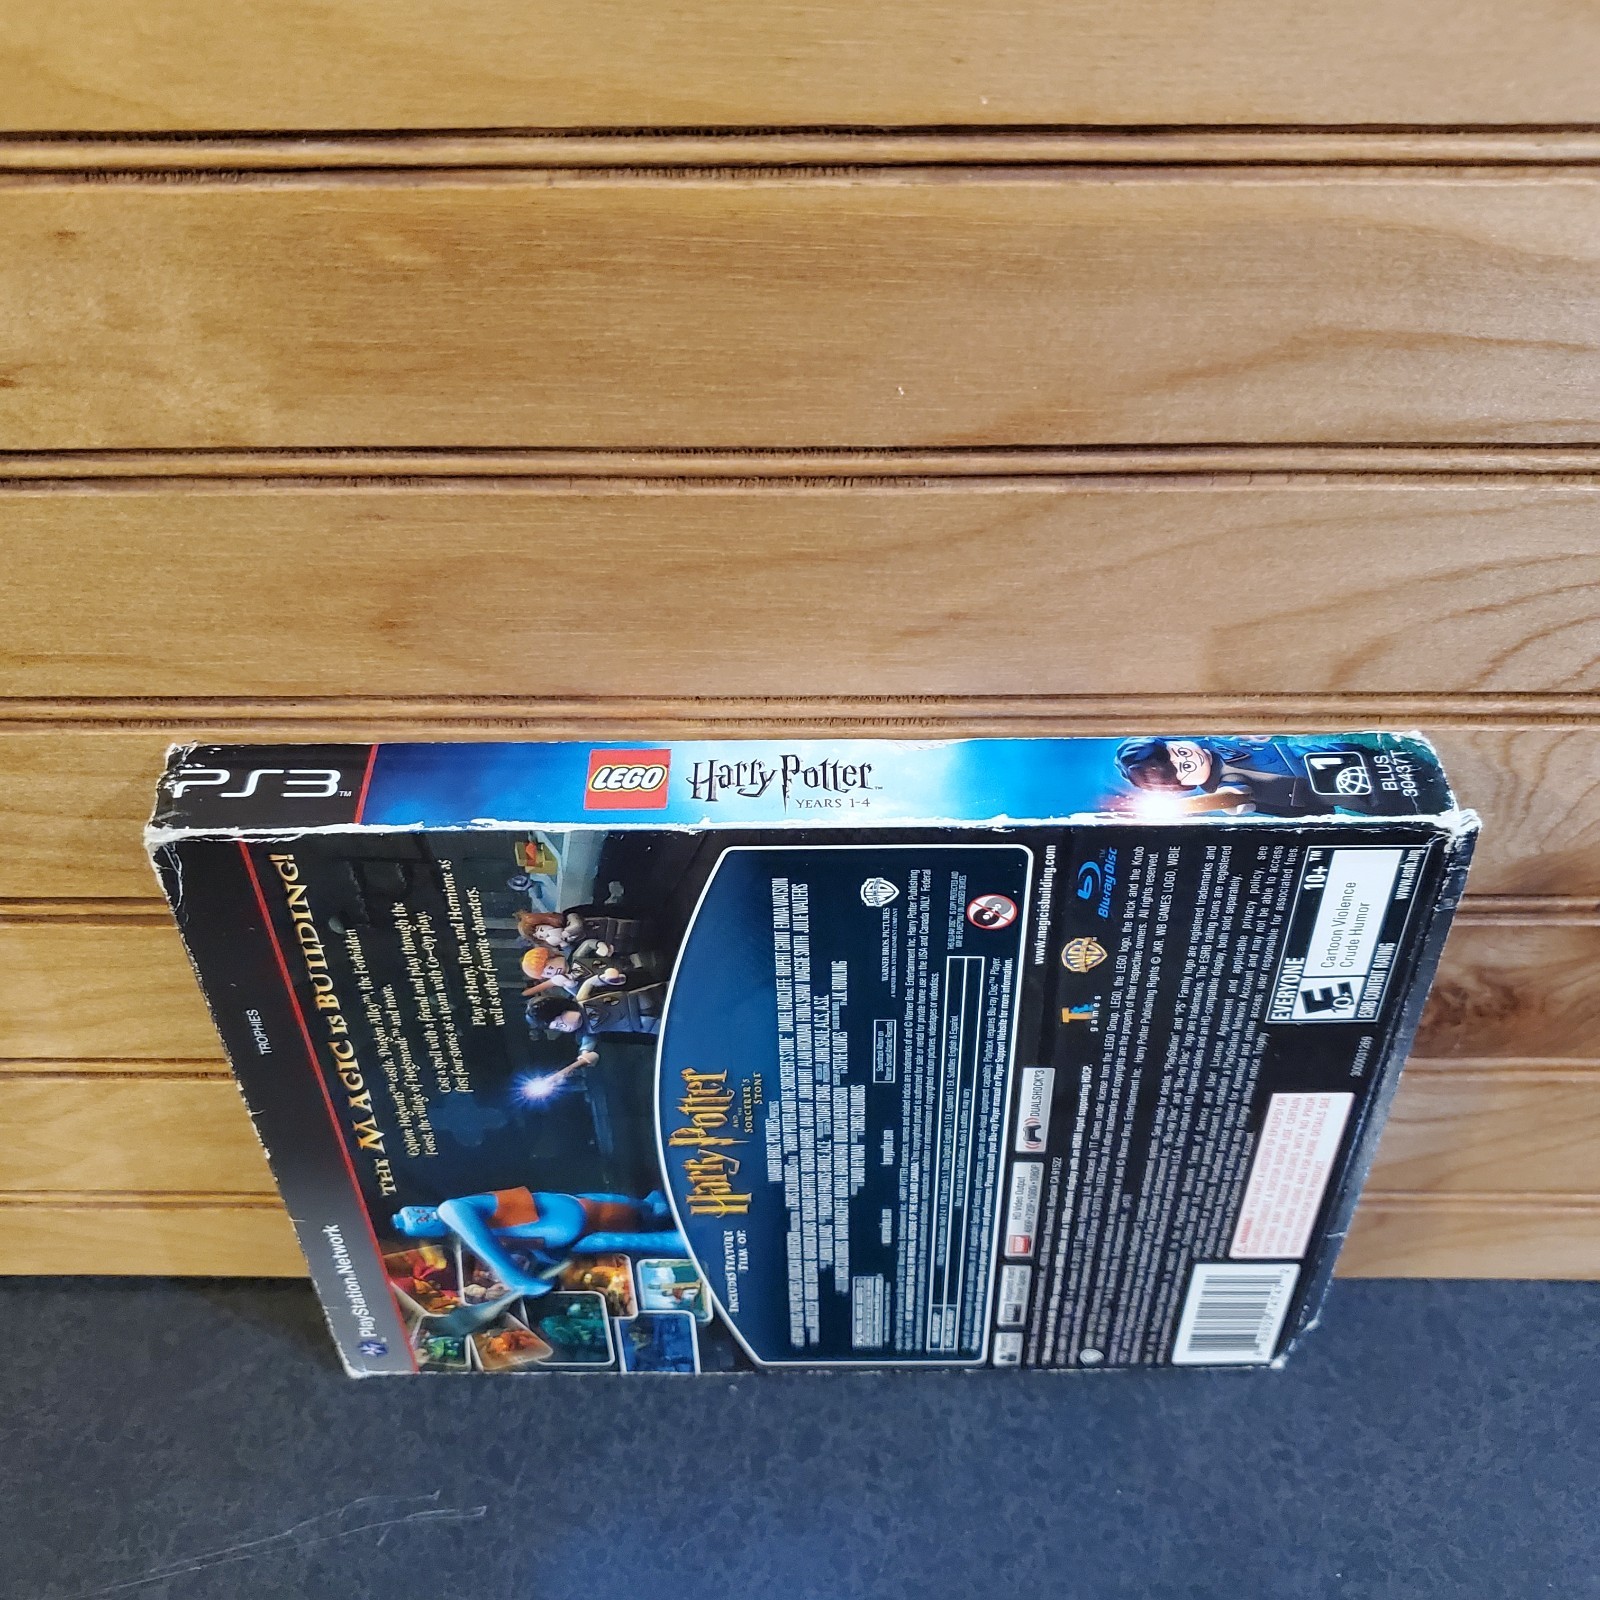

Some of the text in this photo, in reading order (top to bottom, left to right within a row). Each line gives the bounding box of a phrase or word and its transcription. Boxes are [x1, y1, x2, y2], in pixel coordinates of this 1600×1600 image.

[172, 768, 341, 798] PS3
[592, 764, 664, 791] LEGO
[686, 754, 876, 813] Harry Potter
[1374, 755, 1398, 791] BLUS
[795, 798, 870, 809] YEARS 1-4
[1097, 847, 1117, 917] Blu-ray Disc
[1122, 845, 1144, 918] Brick and the Knob
[1137, 852, 1158, 918] All rights reserved.
[1303, 865, 1327, 889] 10+
[1395, 849, 1424, 899] www.esrb.org
[771, 877, 789, 907] WATSON
[906, 869, 922, 936] Harry Potter Publishing
[918, 868, 931, 934] Canada ONLY. Federal
[1034, 845, 1055, 964] www.magicisbuilding.com
[1154, 846, 1180, 936] WB GAMES LOGO, WBIE
[1189, 845, 1217, 943] registered trademarks and
[1221, 874, 1242, 930] sold separately.
[391, 902, 407, 917] the
[415, 911, 435, 933] play.
[772, 903, 789, 928] EMMA
[881, 907, 890, 937] PICTURES
[394, 919, 416, 954] through
[1320, 882, 1356, 968] Cartoon Violence
[1339, 902, 1369, 967] Crude Humor
[345, 929, 368, 974] Forbidden
[437, 859, 486, 1025] Play as Harry, Ron, and Hermione as
[773, 931, 790, 951] GRINT
[406, 956, 424, 976] play
[466, 887, 505, 1025] well as other favorite characters.
[774, 951, 791, 976] RUPERT
[881, 955, 889, 981] WARNER
[357, 975, 373, 990] the
[408, 977, 425, 994] and
[427, 969, 444, 990] with
[831, 960, 847, 990] ROWLING
[1271, 957, 1304, 1020] EVERYONE
[1357, 942, 1395, 1018] ESRB CONTENT RATING
[382, 983, 397, 1008] more.
[436, 991, 451, 1014] team
[775, 978, 792, 1010] RADCLIFFE
[791, 883, 813, 1100] JOHN HURT ALAN RICKMAN FIONA SHAW MAGGIE SMITH JULIE WALTERS
[1301, 982, 1353, 1013] E
[385, 1009, 401, 1026] and
[414, 996, 435, 1021] friend
[777, 1011, 793, 1032] DANIEL
[246, 1009, 271, 1054] TROPHIES
[272, 854, 396, 1195] THE MAGIC IS BUILDING!
[442, 1021, 455, 1031] as
[373, 1026, 391, 1057] Diagon
[423, 1029, 439, 1049] with
[445, 1032, 462, 1057] stories
[831, 1031, 848, 1052] KLOVES
[428, 1050, 446, 1069] spell
[450, 1057, 469, 1075] four
[814, 1045, 830, 1063] JOHN
[831, 1052, 848, 1070] STEVE
[436, 1076, 451, 1093] Cast
[454, 1076, 473, 1092] first
[779, 1055, 795, 1089] SORCERER'S
[404, 1081, 422, 1092] of
[752, 1072, 762, 1104] STONE
[780, 1087, 796, 1100] THE
[815, 1083, 830, 1101] CRAIG
[409, 1093, 427, 1117] village
[741, 1078, 753, 1133] SORCERER'S
[780, 1100, 796, 1113] AND
[815, 1101, 831, 1122] STUART
[417, 1118, 432, 1130] the
[781, 1112, 797, 1133] POTTER
[403, 1128, 420, 1156] Explore
[668, 1066, 752, 1219] Harry Potter
[764, 1116, 782, 1181] WARNER BROS. PICTURES
[723, 1230, 739, 1312] INCLUDES FEATURE
[737, 1248, 748, 1270] FILM
[323, 1224, 375, 1337] PlayStation Network
